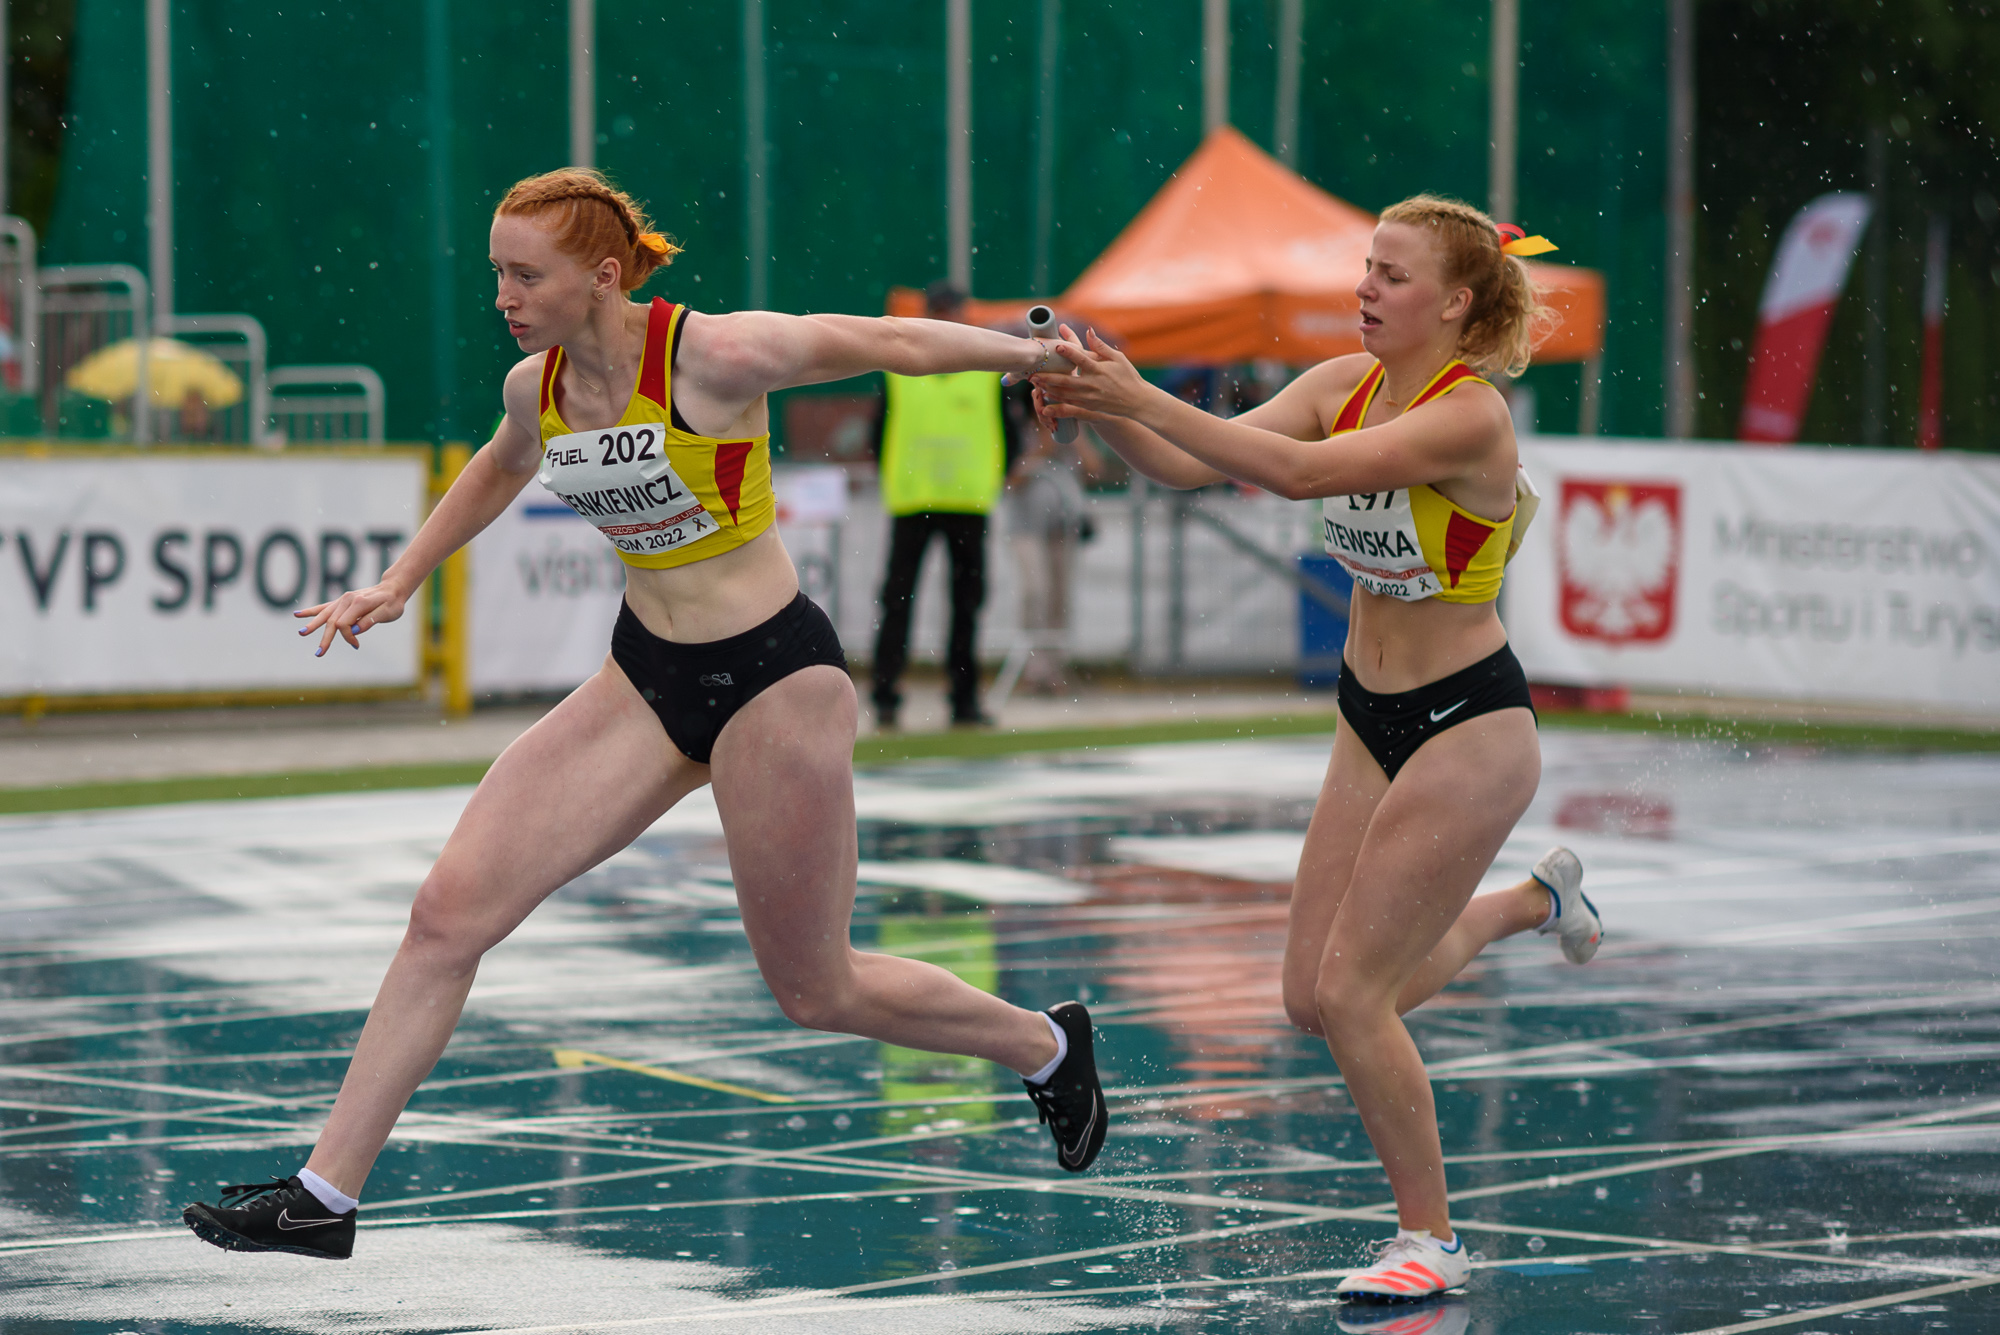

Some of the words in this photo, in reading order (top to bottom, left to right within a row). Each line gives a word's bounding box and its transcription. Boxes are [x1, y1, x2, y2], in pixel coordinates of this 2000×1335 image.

[598, 428, 657, 466] 202
[556, 474, 682, 517] IENKIEWICZ
[681, 506, 701, 520] U20
[645, 527, 687, 549] 2022
[1324, 516, 1418, 558] ITEWSKA
[0, 530, 127, 613] VP
[150, 527, 405, 614] SPORT
[1376, 582, 1410, 597] 2022
[699, 672, 734, 687] esa
